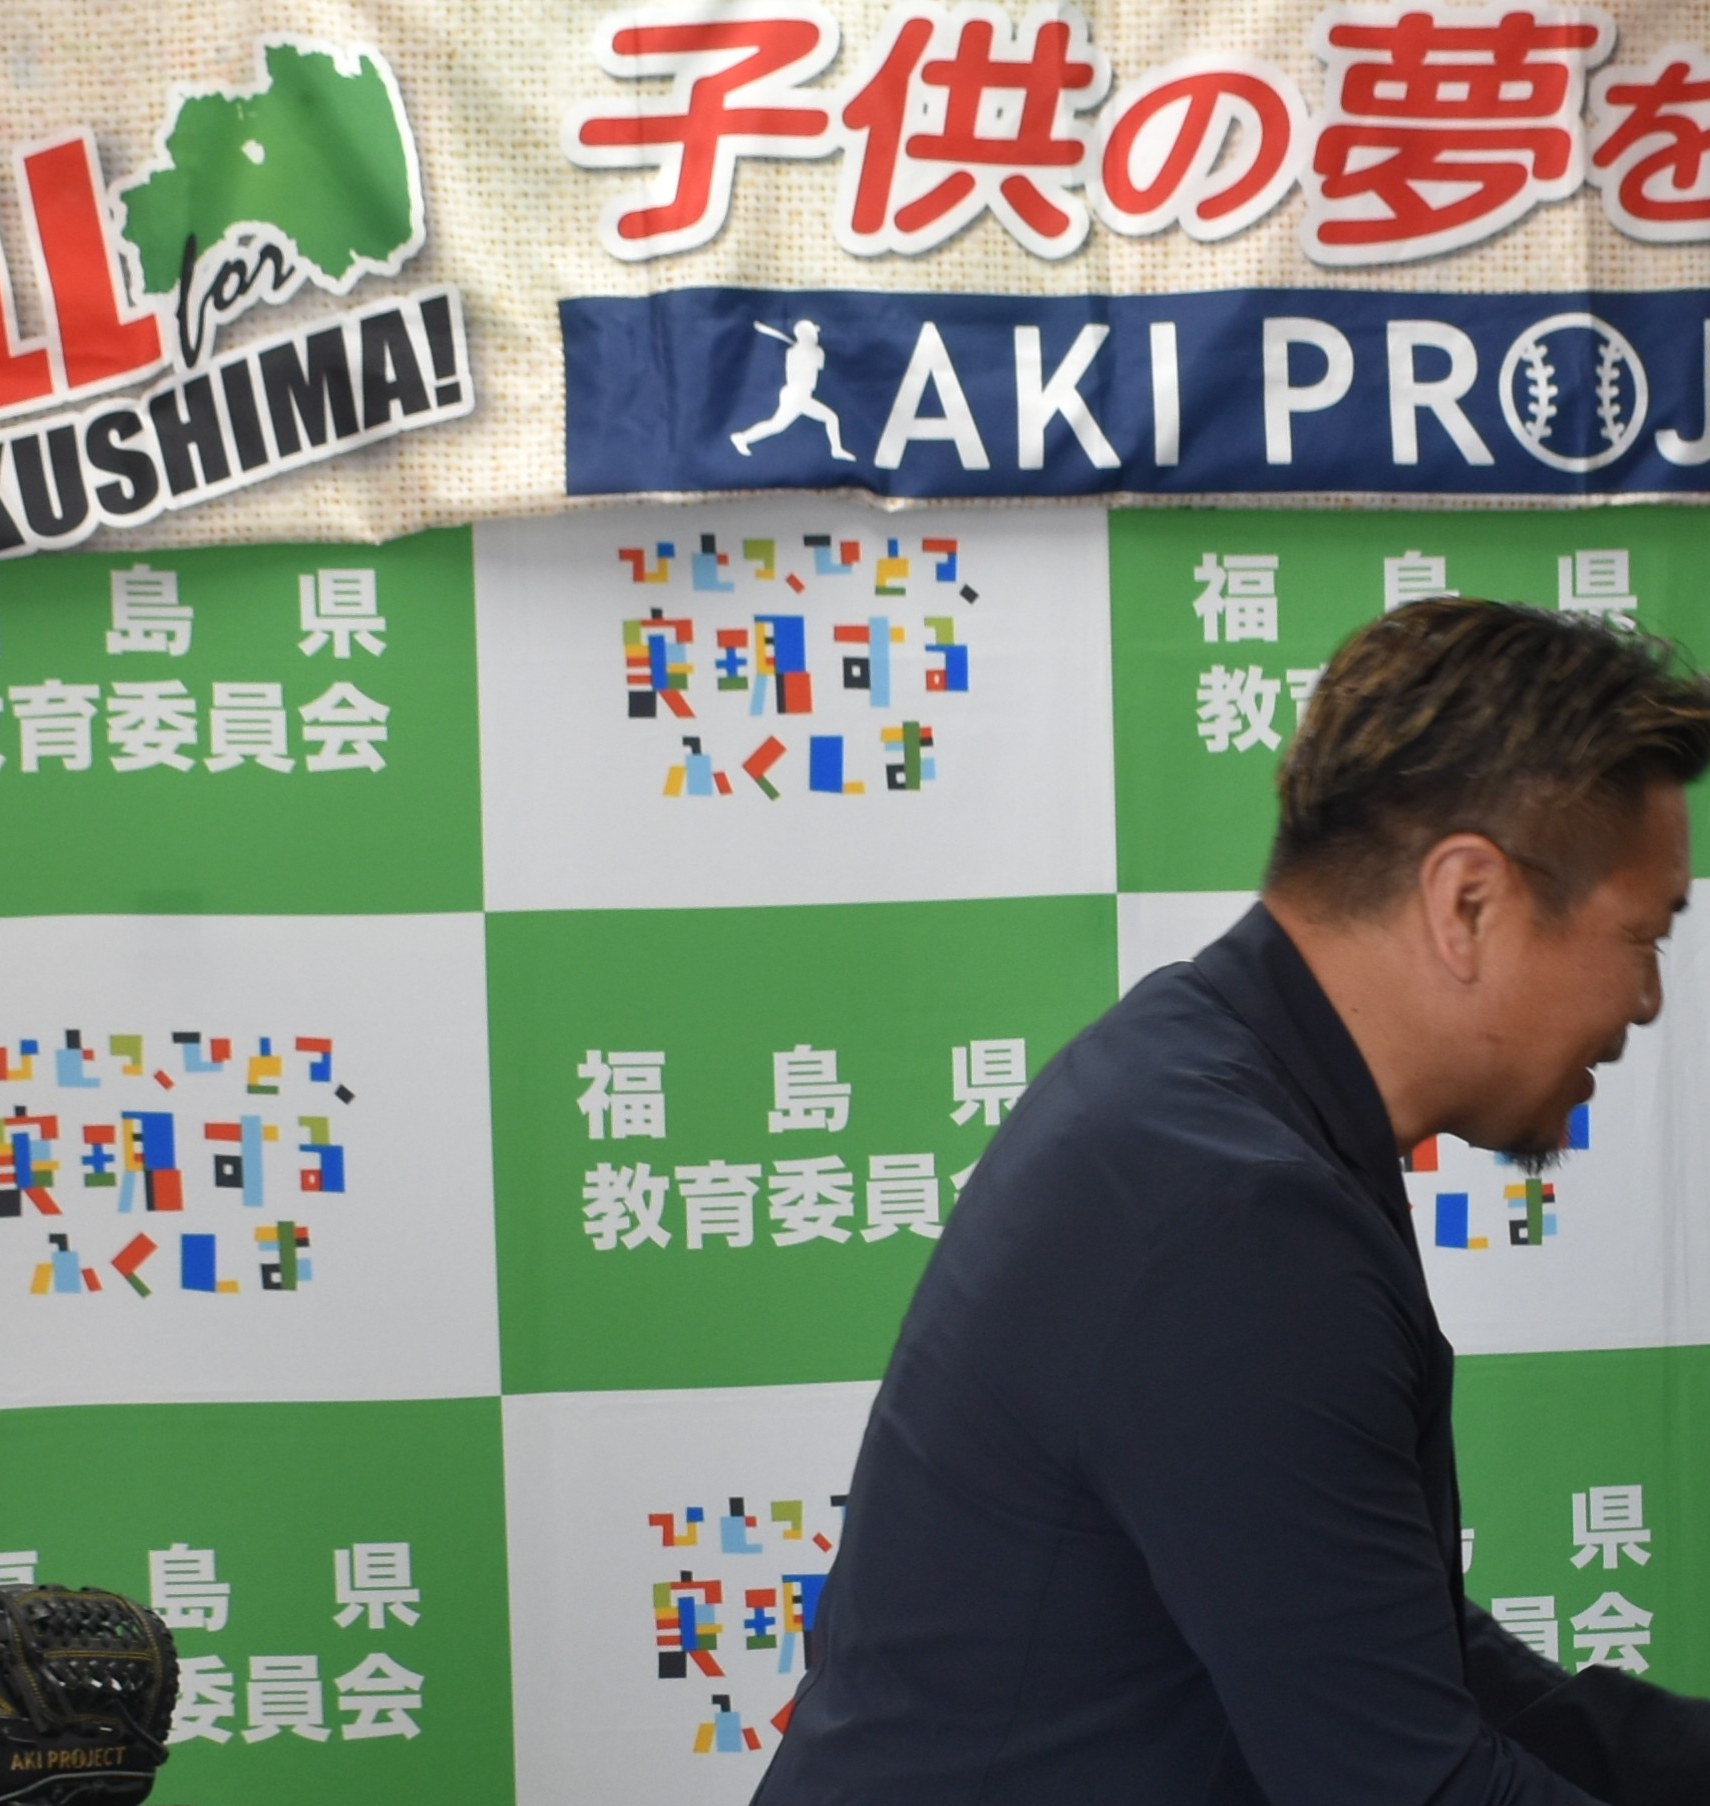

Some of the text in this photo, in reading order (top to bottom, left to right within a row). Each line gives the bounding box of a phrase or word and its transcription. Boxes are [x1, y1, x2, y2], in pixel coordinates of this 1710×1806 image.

[177, 233, 295, 369] for
[874, 321, 1179, 470] AKI
[577, 1038, 1029, 1140] 福島県
[583, 1152, 981, 1251] 教育委員
[169, 1652, 424, 1747] 委員会
[10, 1745, 128, 1772] AKI PROJECT
